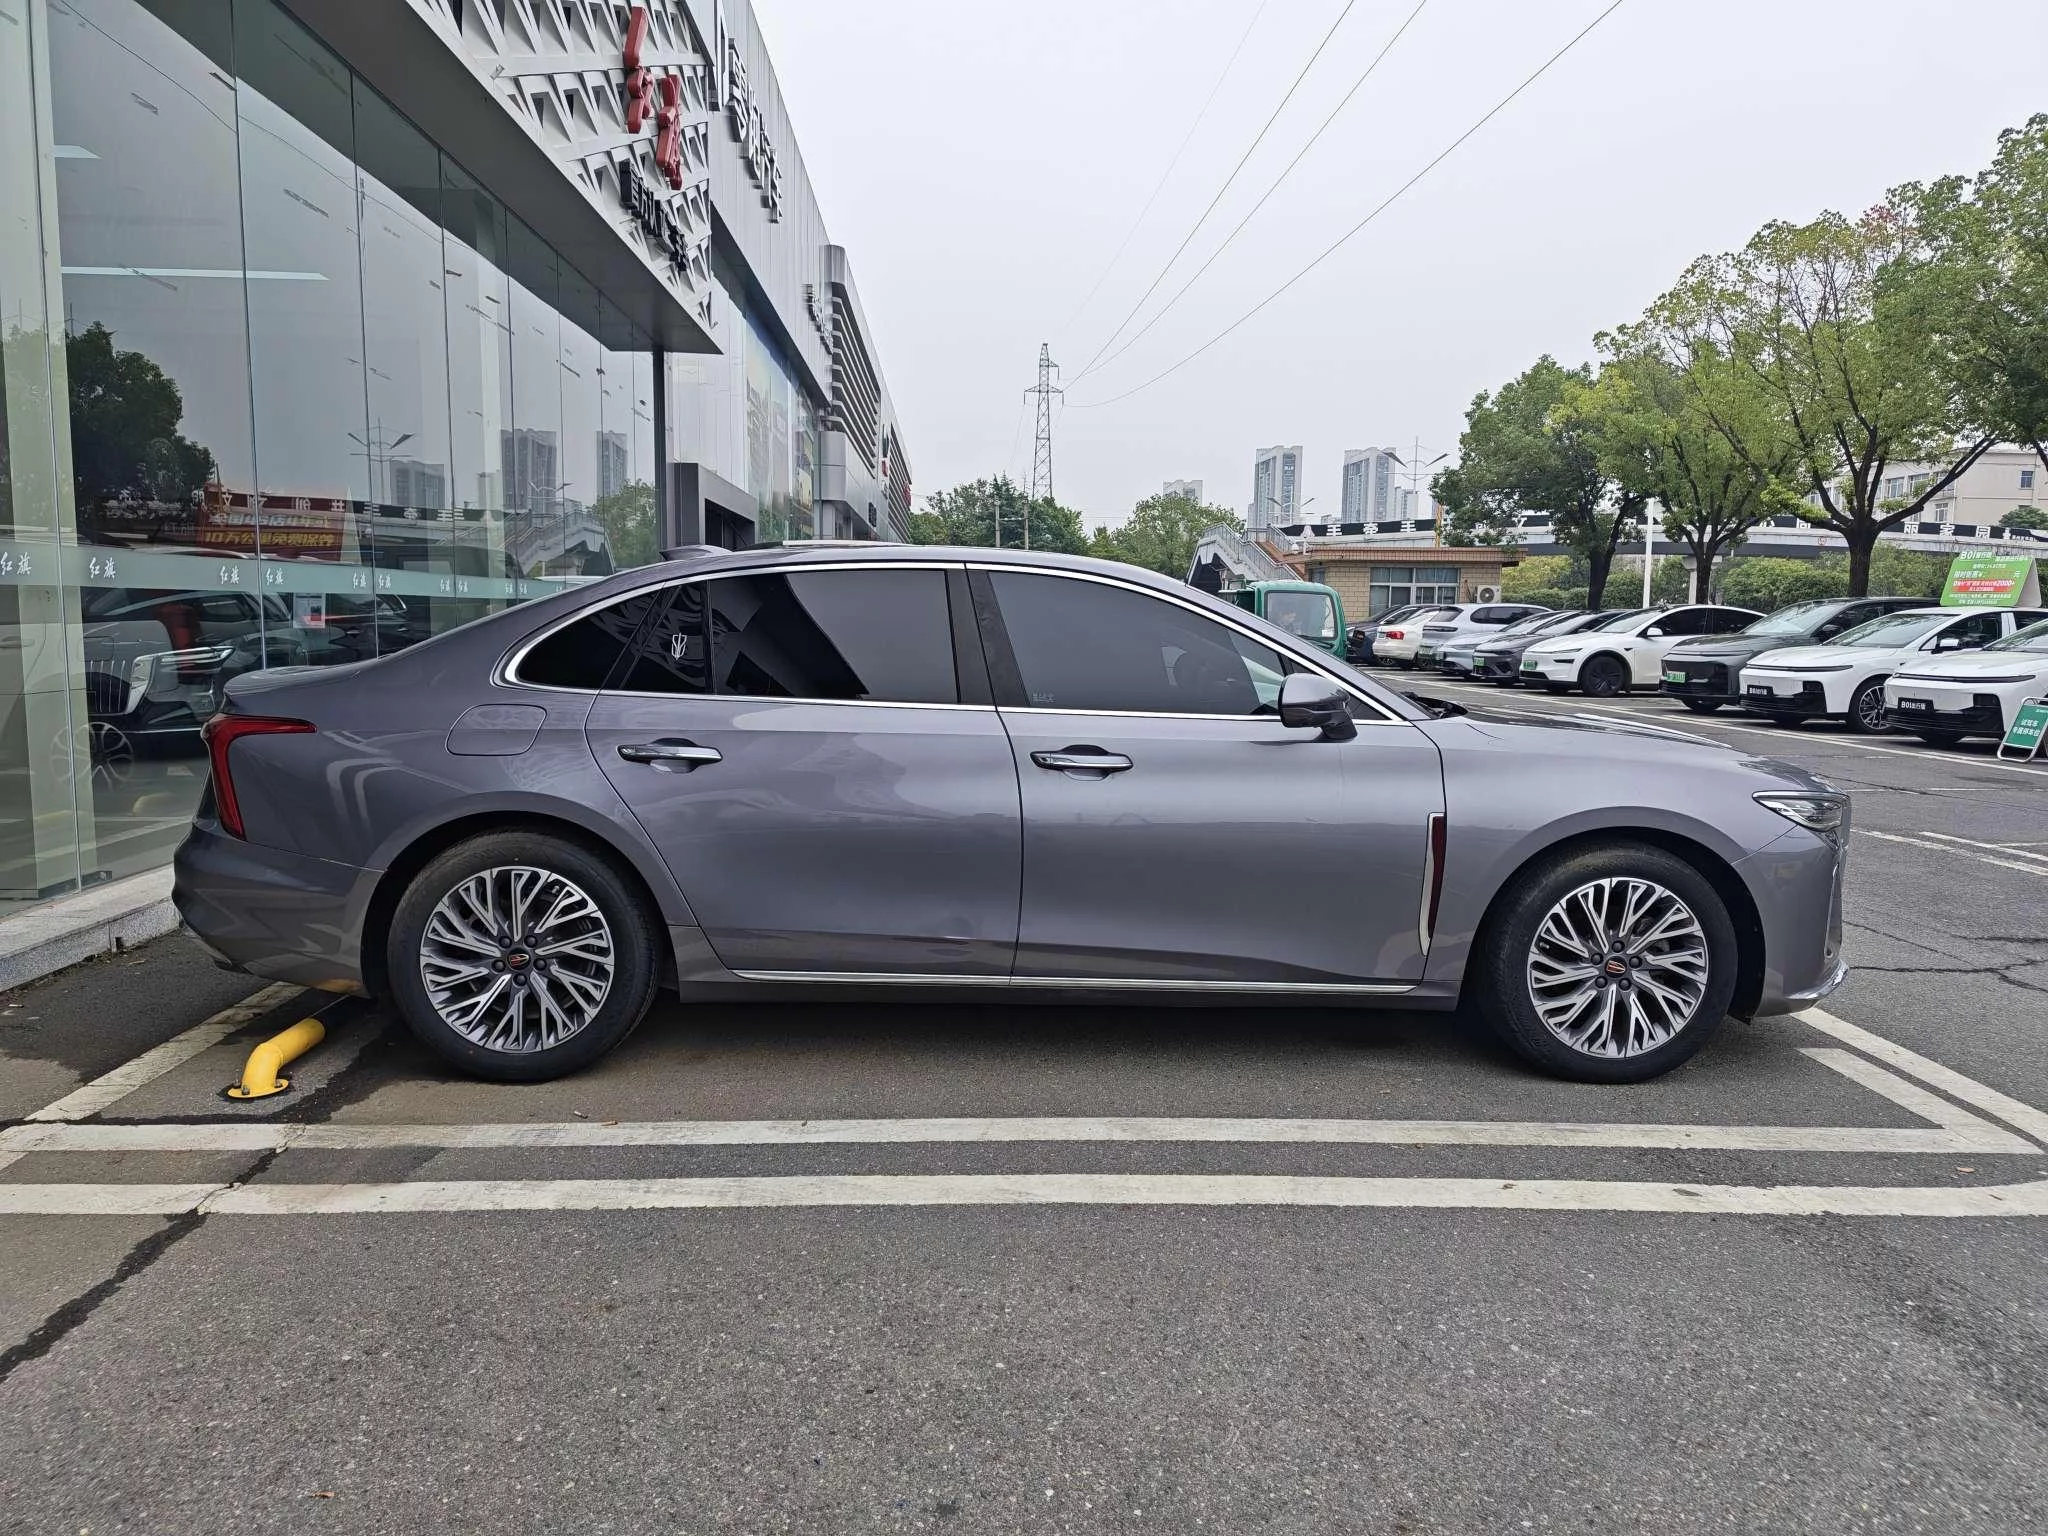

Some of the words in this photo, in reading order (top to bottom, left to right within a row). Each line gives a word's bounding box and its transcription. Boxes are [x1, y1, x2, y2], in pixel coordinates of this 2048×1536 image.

[88, 556, 117, 580] 红旗
[219, 565, 241, 585] 红旗
[265, 567, 285, 586] 红旗
